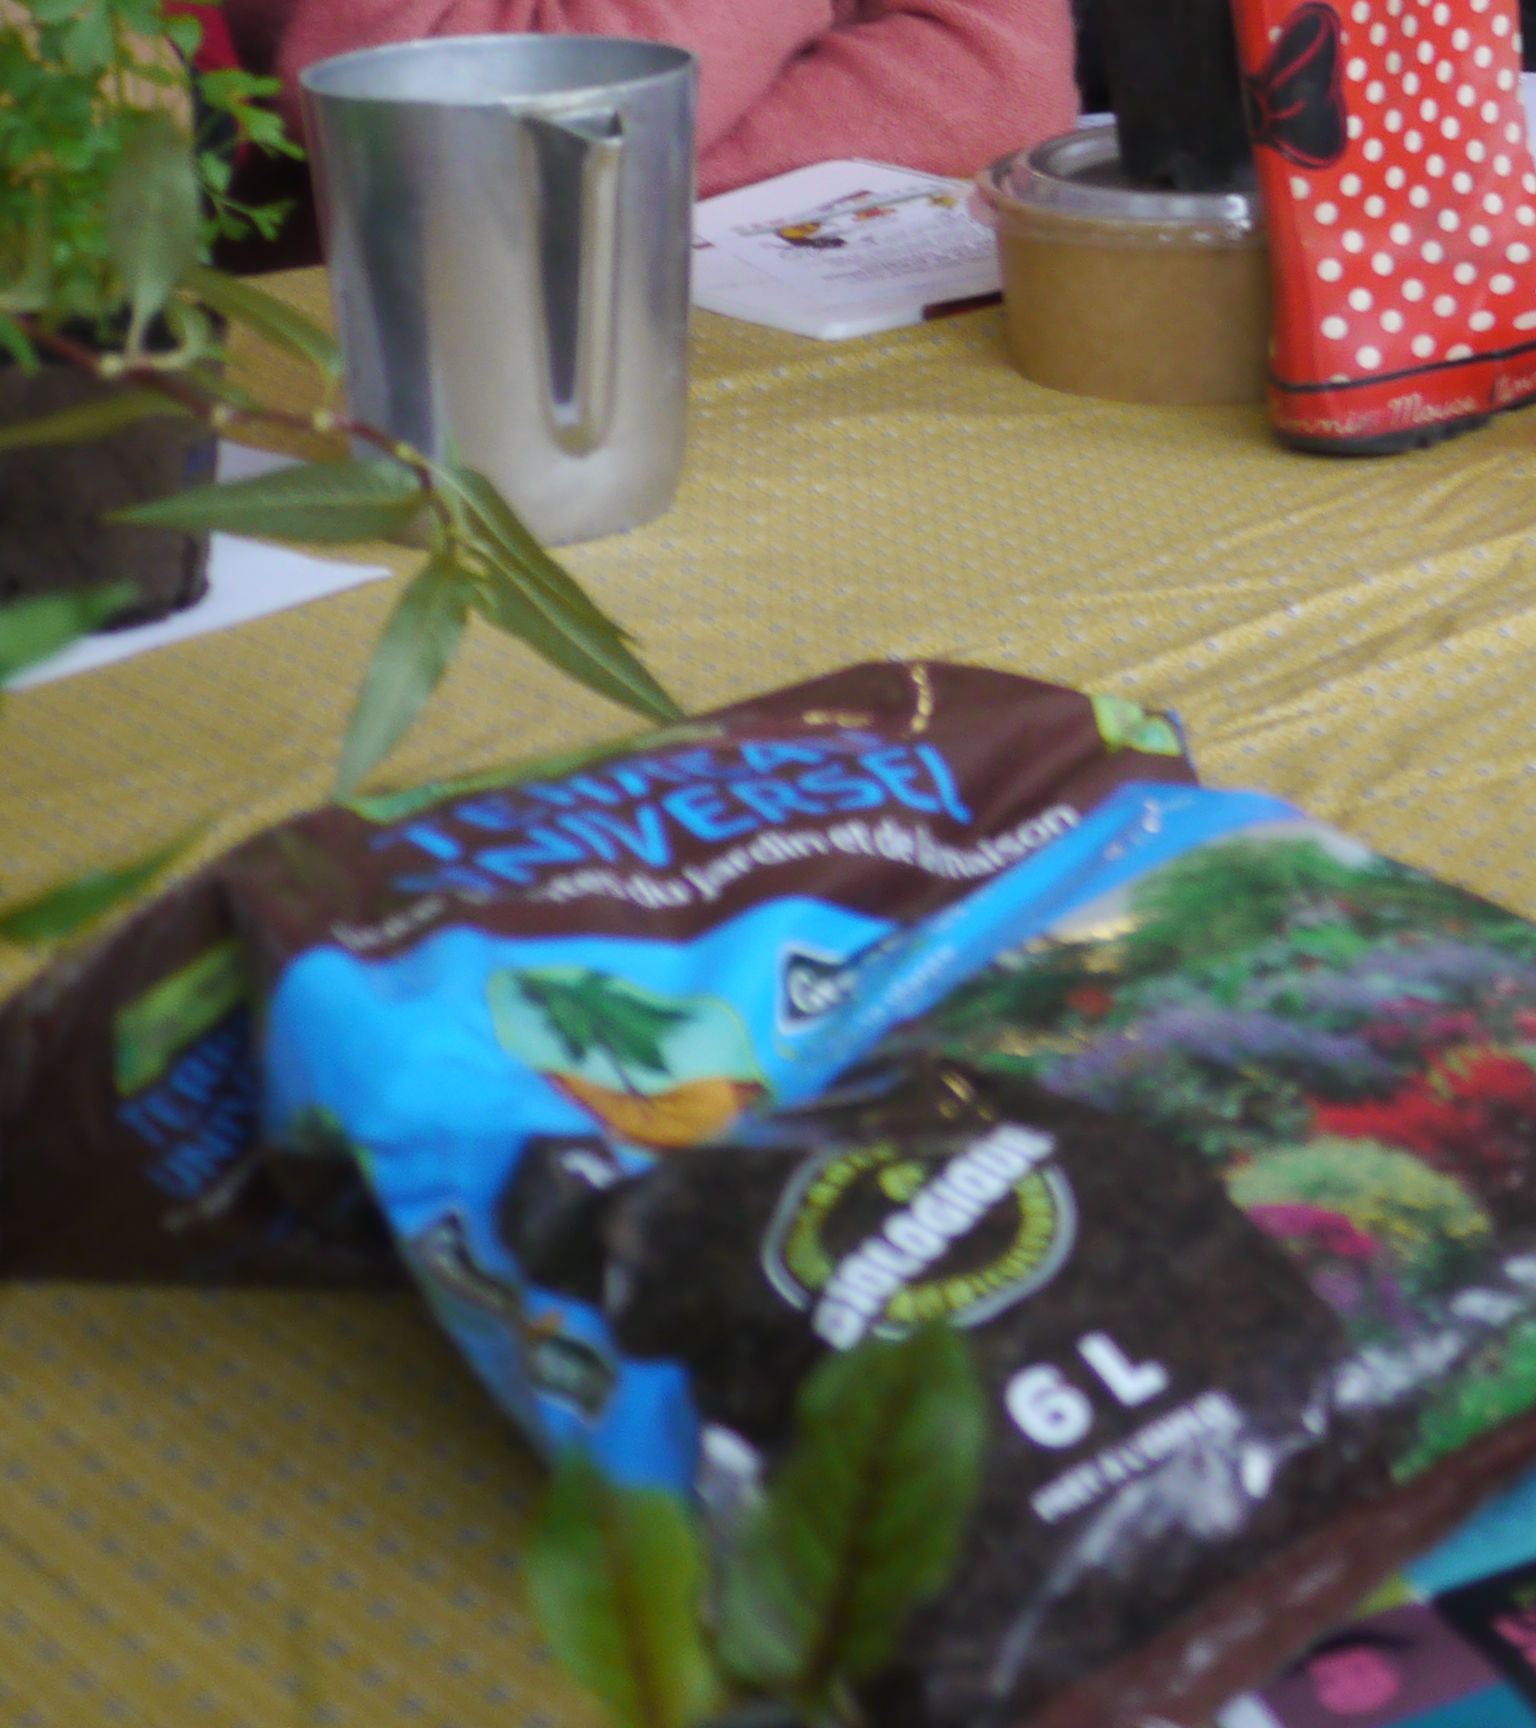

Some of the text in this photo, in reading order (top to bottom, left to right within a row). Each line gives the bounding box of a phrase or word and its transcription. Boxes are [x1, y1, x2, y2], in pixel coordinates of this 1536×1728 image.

[811, 1120, 1056, 1352] BIOLOGIQUE
[1003, 1329, 1171, 1450] 6 L
